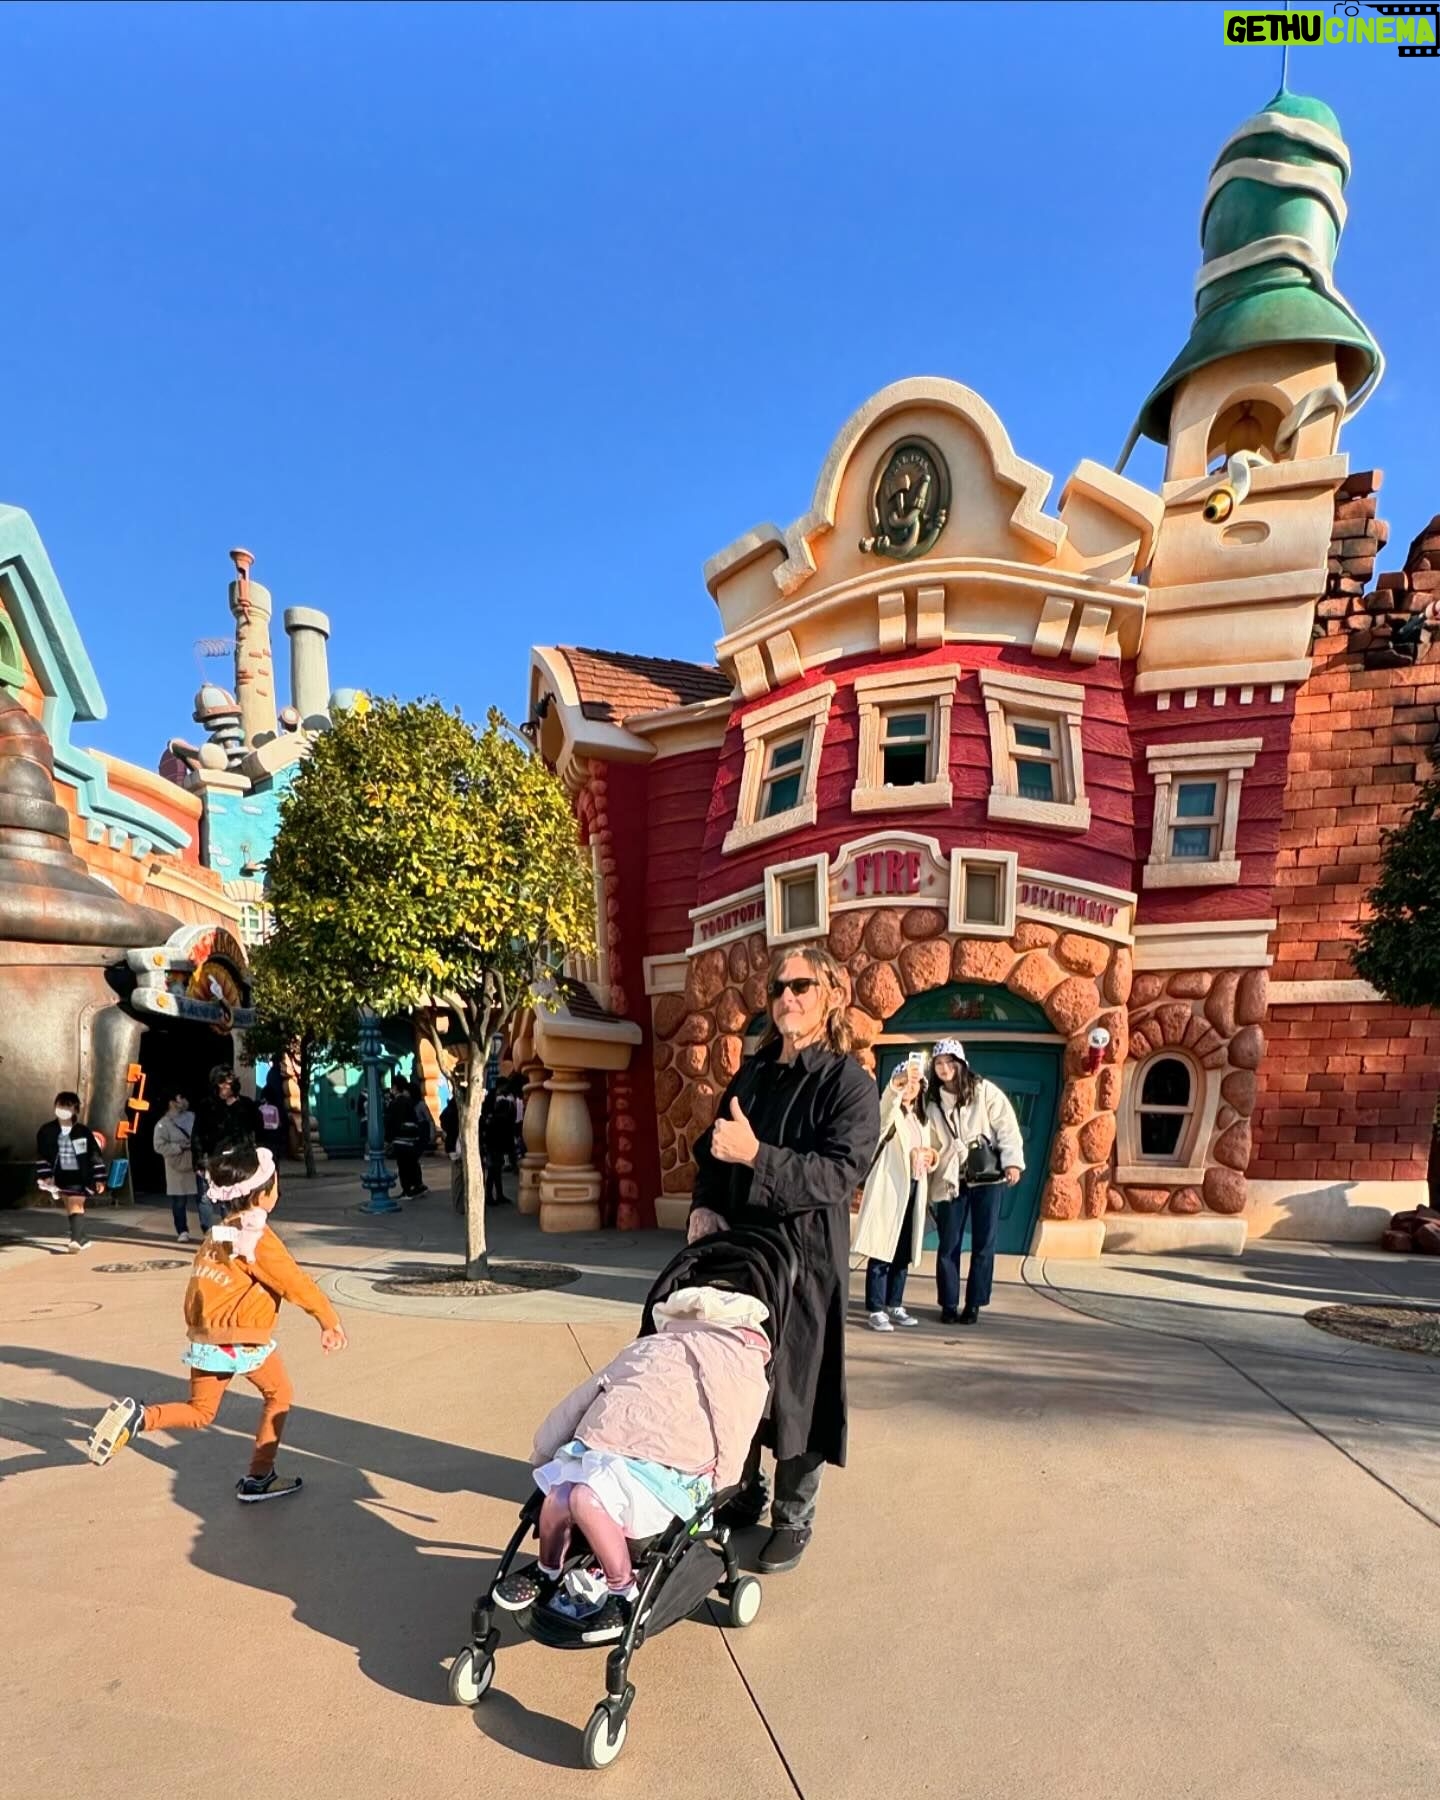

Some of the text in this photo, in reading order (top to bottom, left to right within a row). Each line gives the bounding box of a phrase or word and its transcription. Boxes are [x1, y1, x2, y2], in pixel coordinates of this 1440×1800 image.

[700, 850, 1118, 940] TOONTOWN FIRE DEPARTMENT
